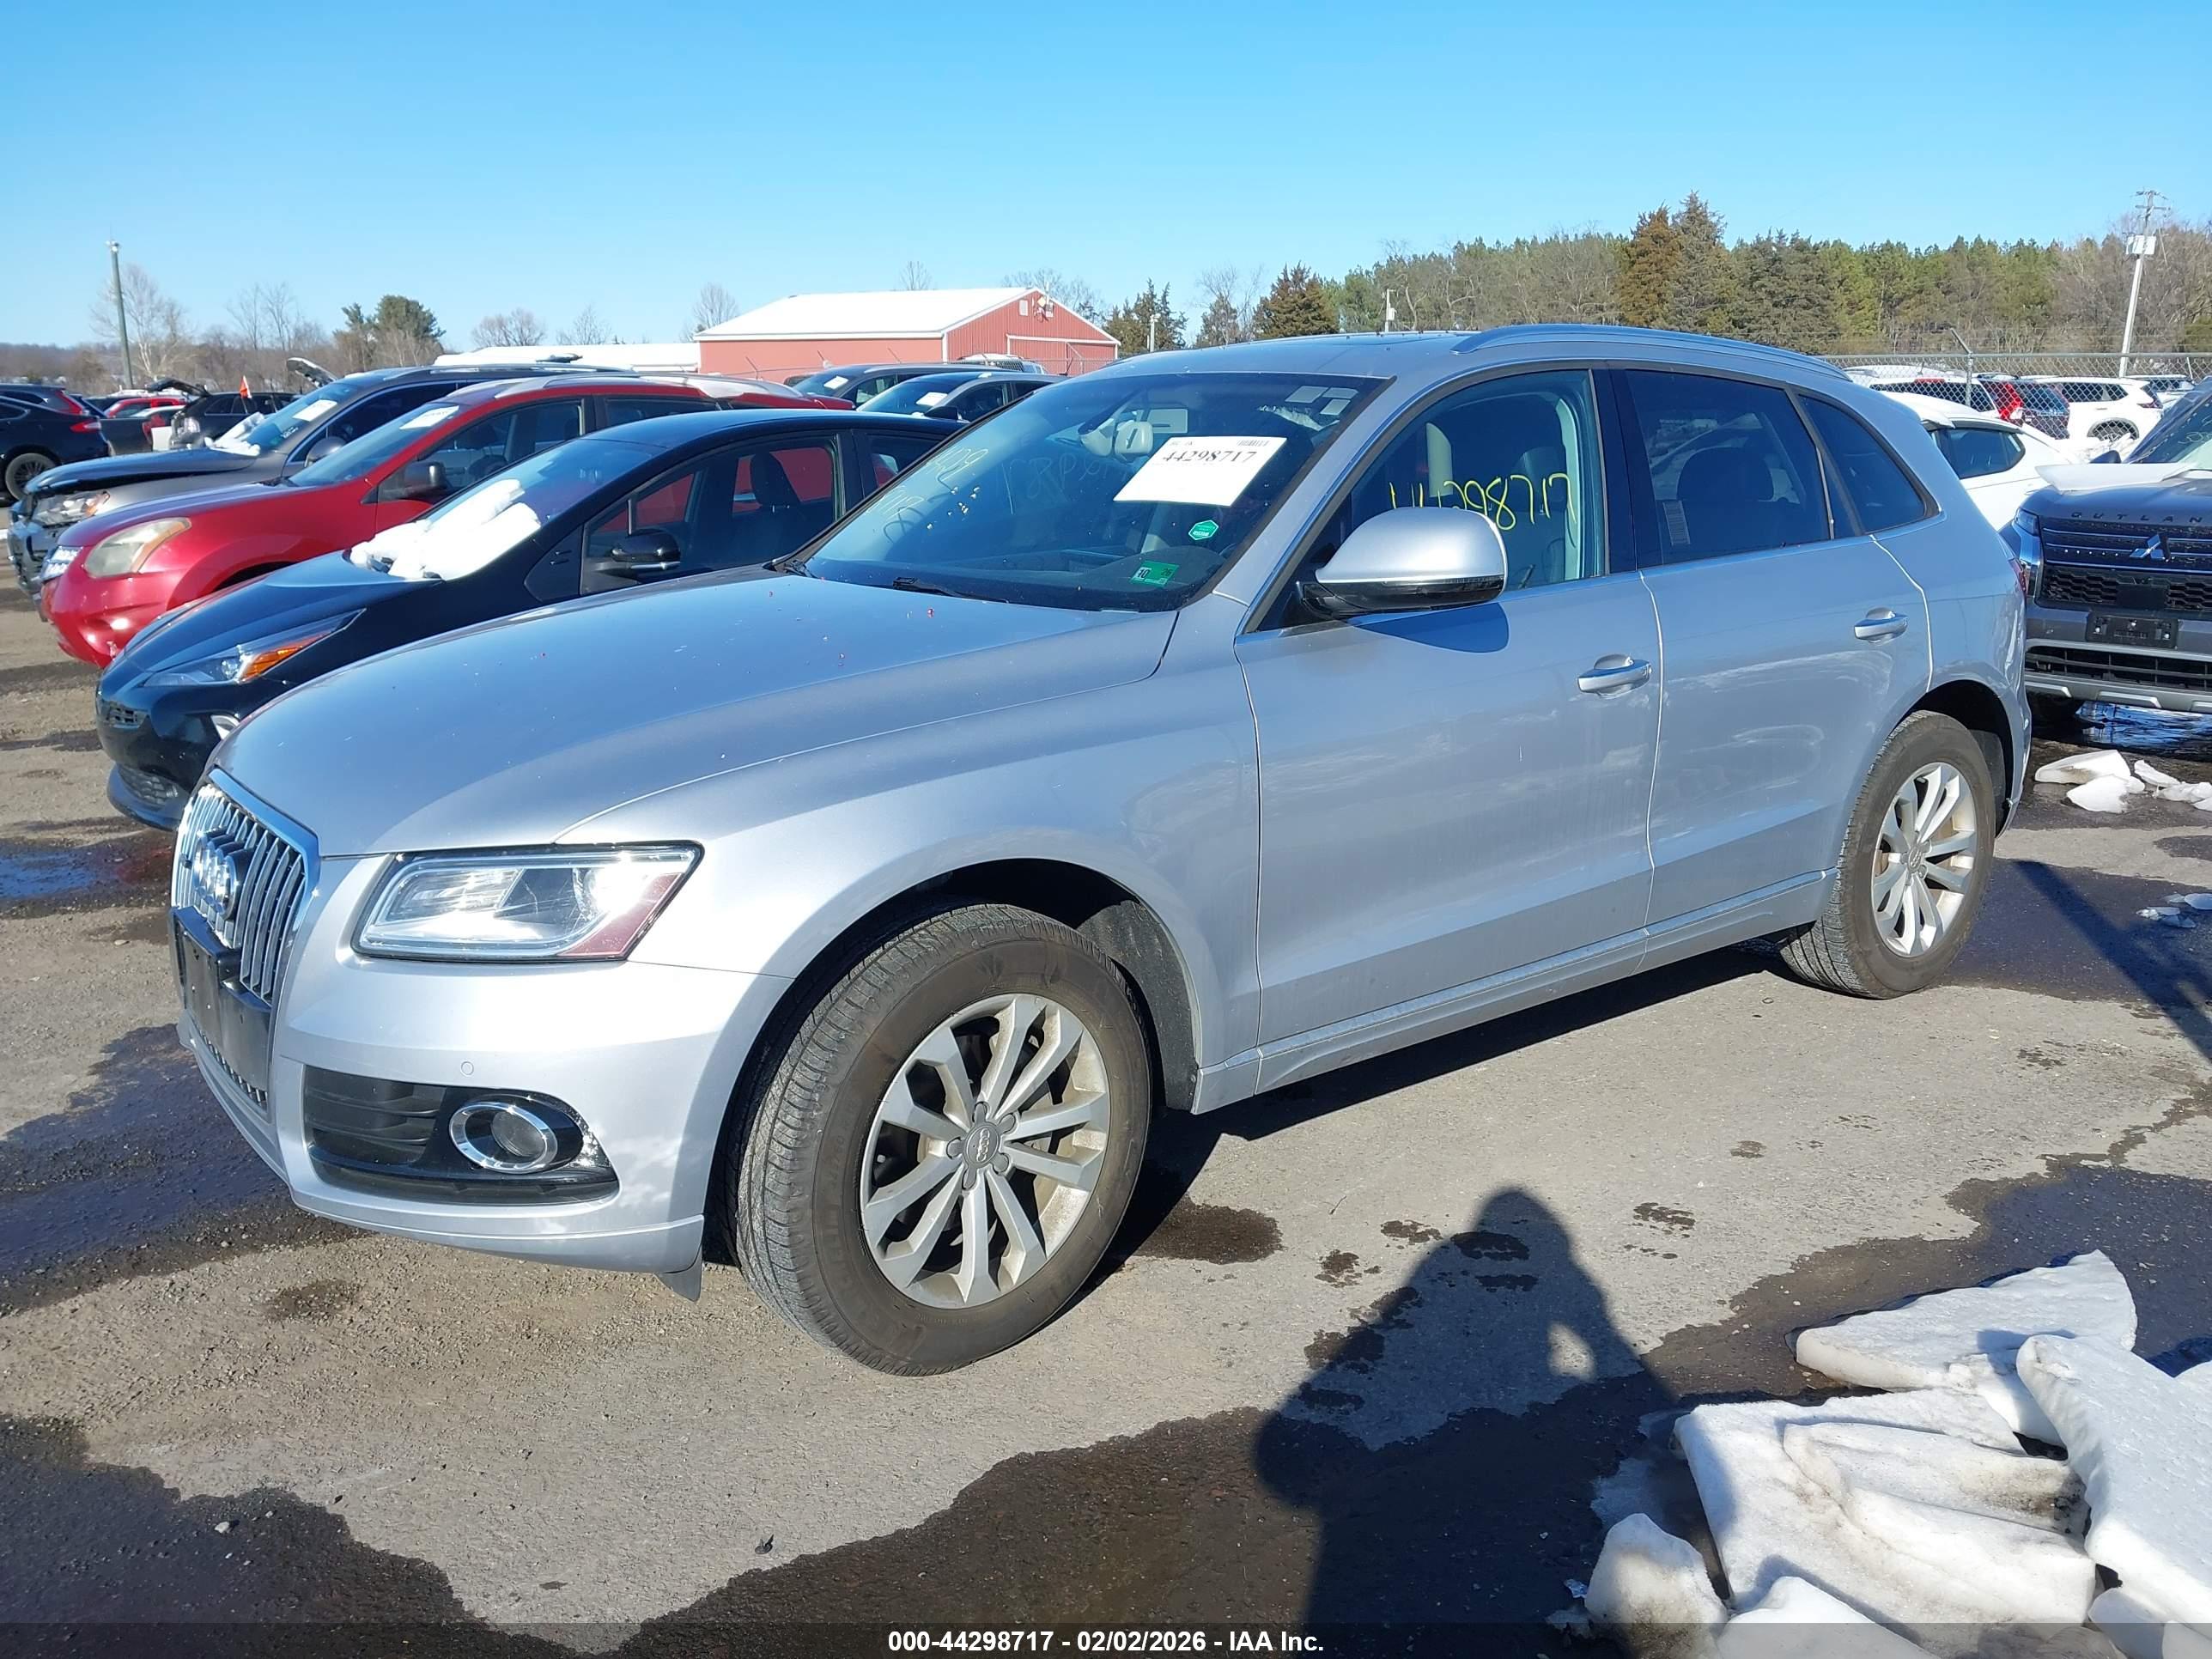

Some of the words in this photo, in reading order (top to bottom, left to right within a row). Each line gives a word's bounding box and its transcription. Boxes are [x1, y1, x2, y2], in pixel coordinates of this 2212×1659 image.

[1162, 450, 1259, 464] 44298717
[2070, 512, 2204, 524] OUTLAN
[1138, 568, 1151, 579] 10
[1161, 568, 1174, 577] 26
